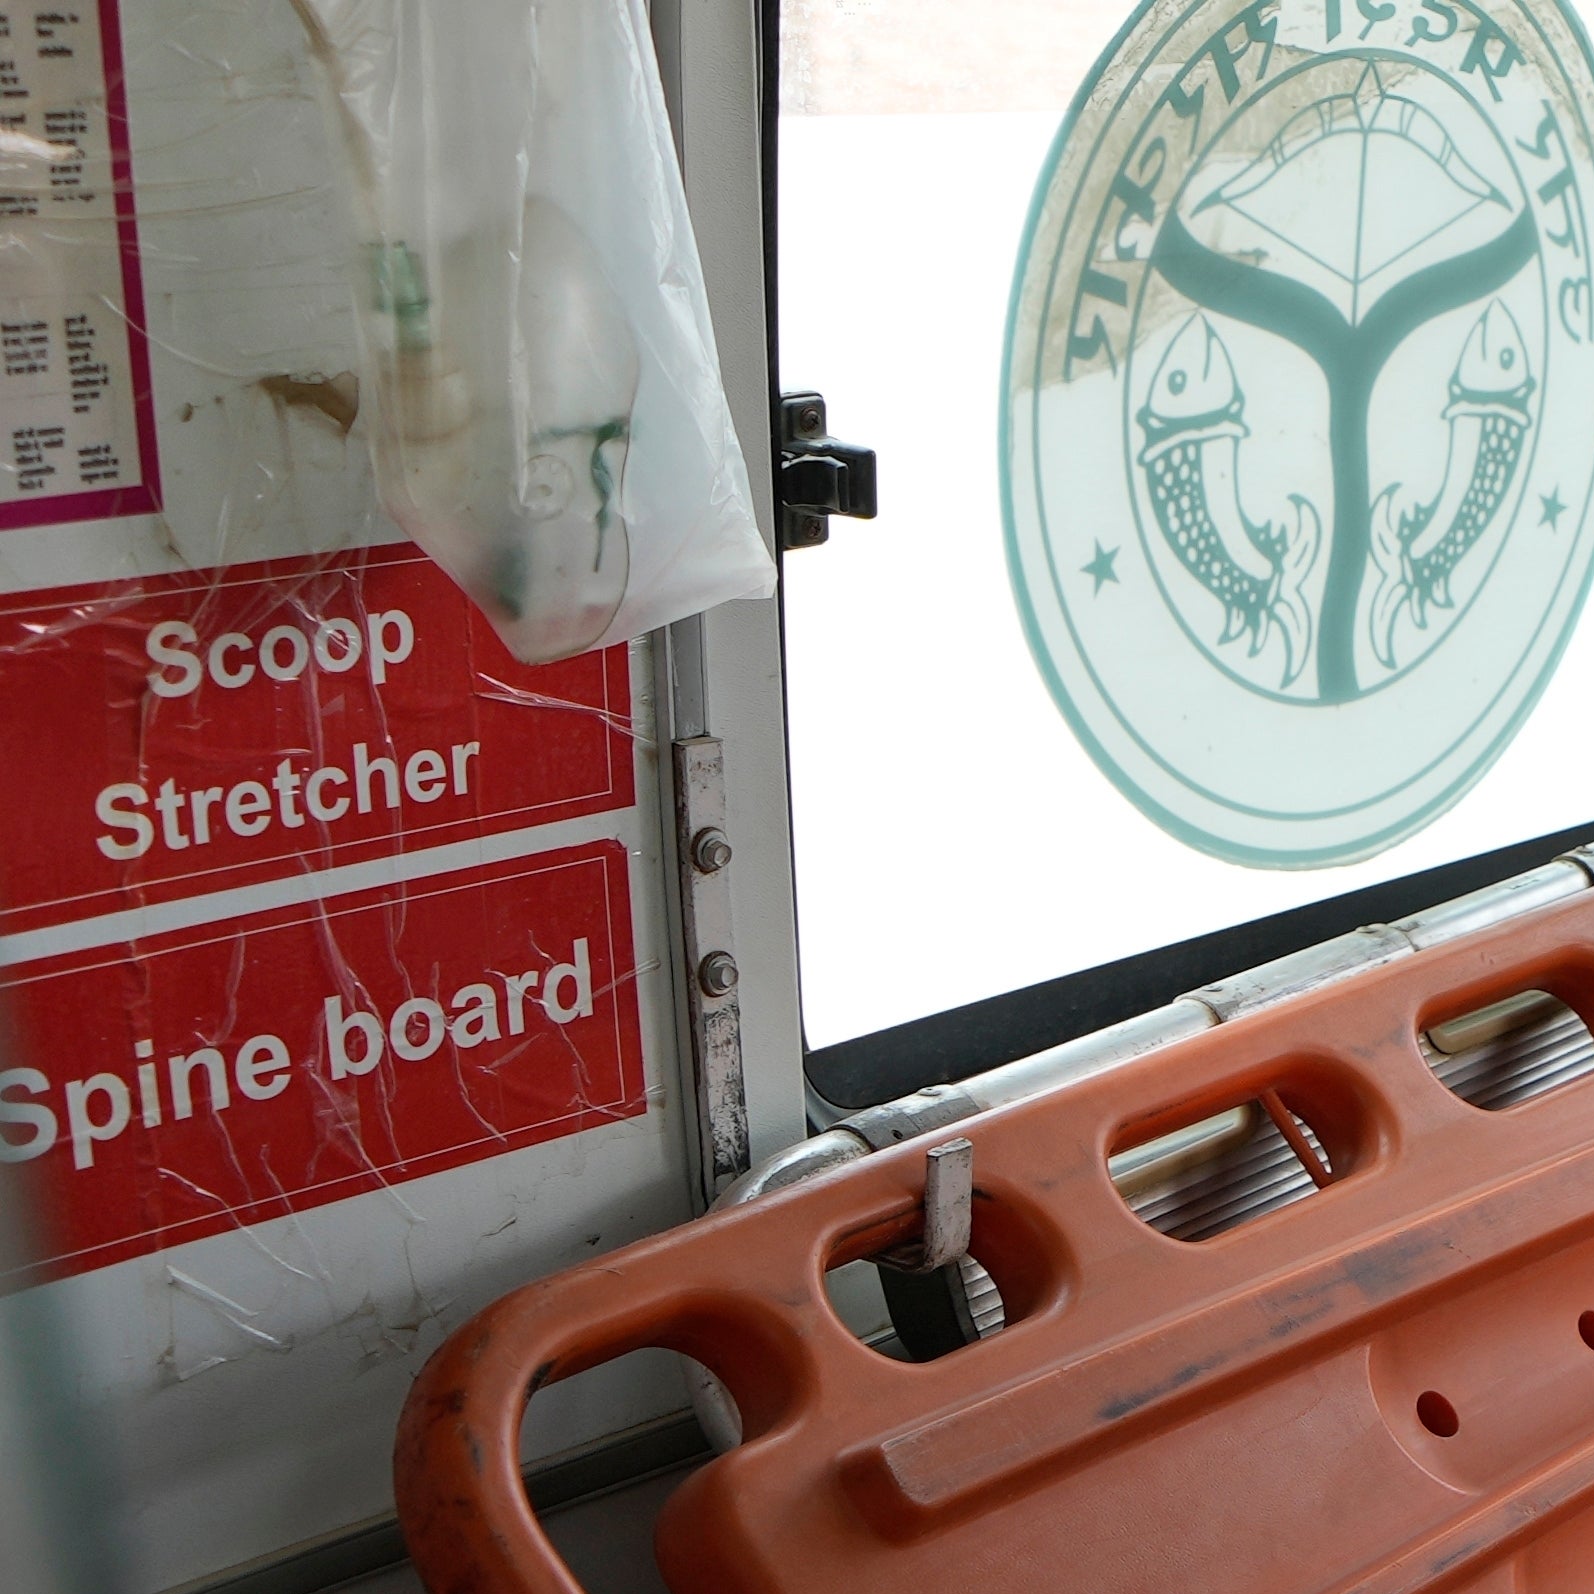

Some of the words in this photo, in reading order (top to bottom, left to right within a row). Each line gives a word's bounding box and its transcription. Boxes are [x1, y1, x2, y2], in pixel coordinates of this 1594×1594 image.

[144, 607, 415, 699] Scoop
[95, 741, 480, 861] Stretcher
[0, 1034, 292, 1171] Spine
[325, 937, 594, 1080] board
